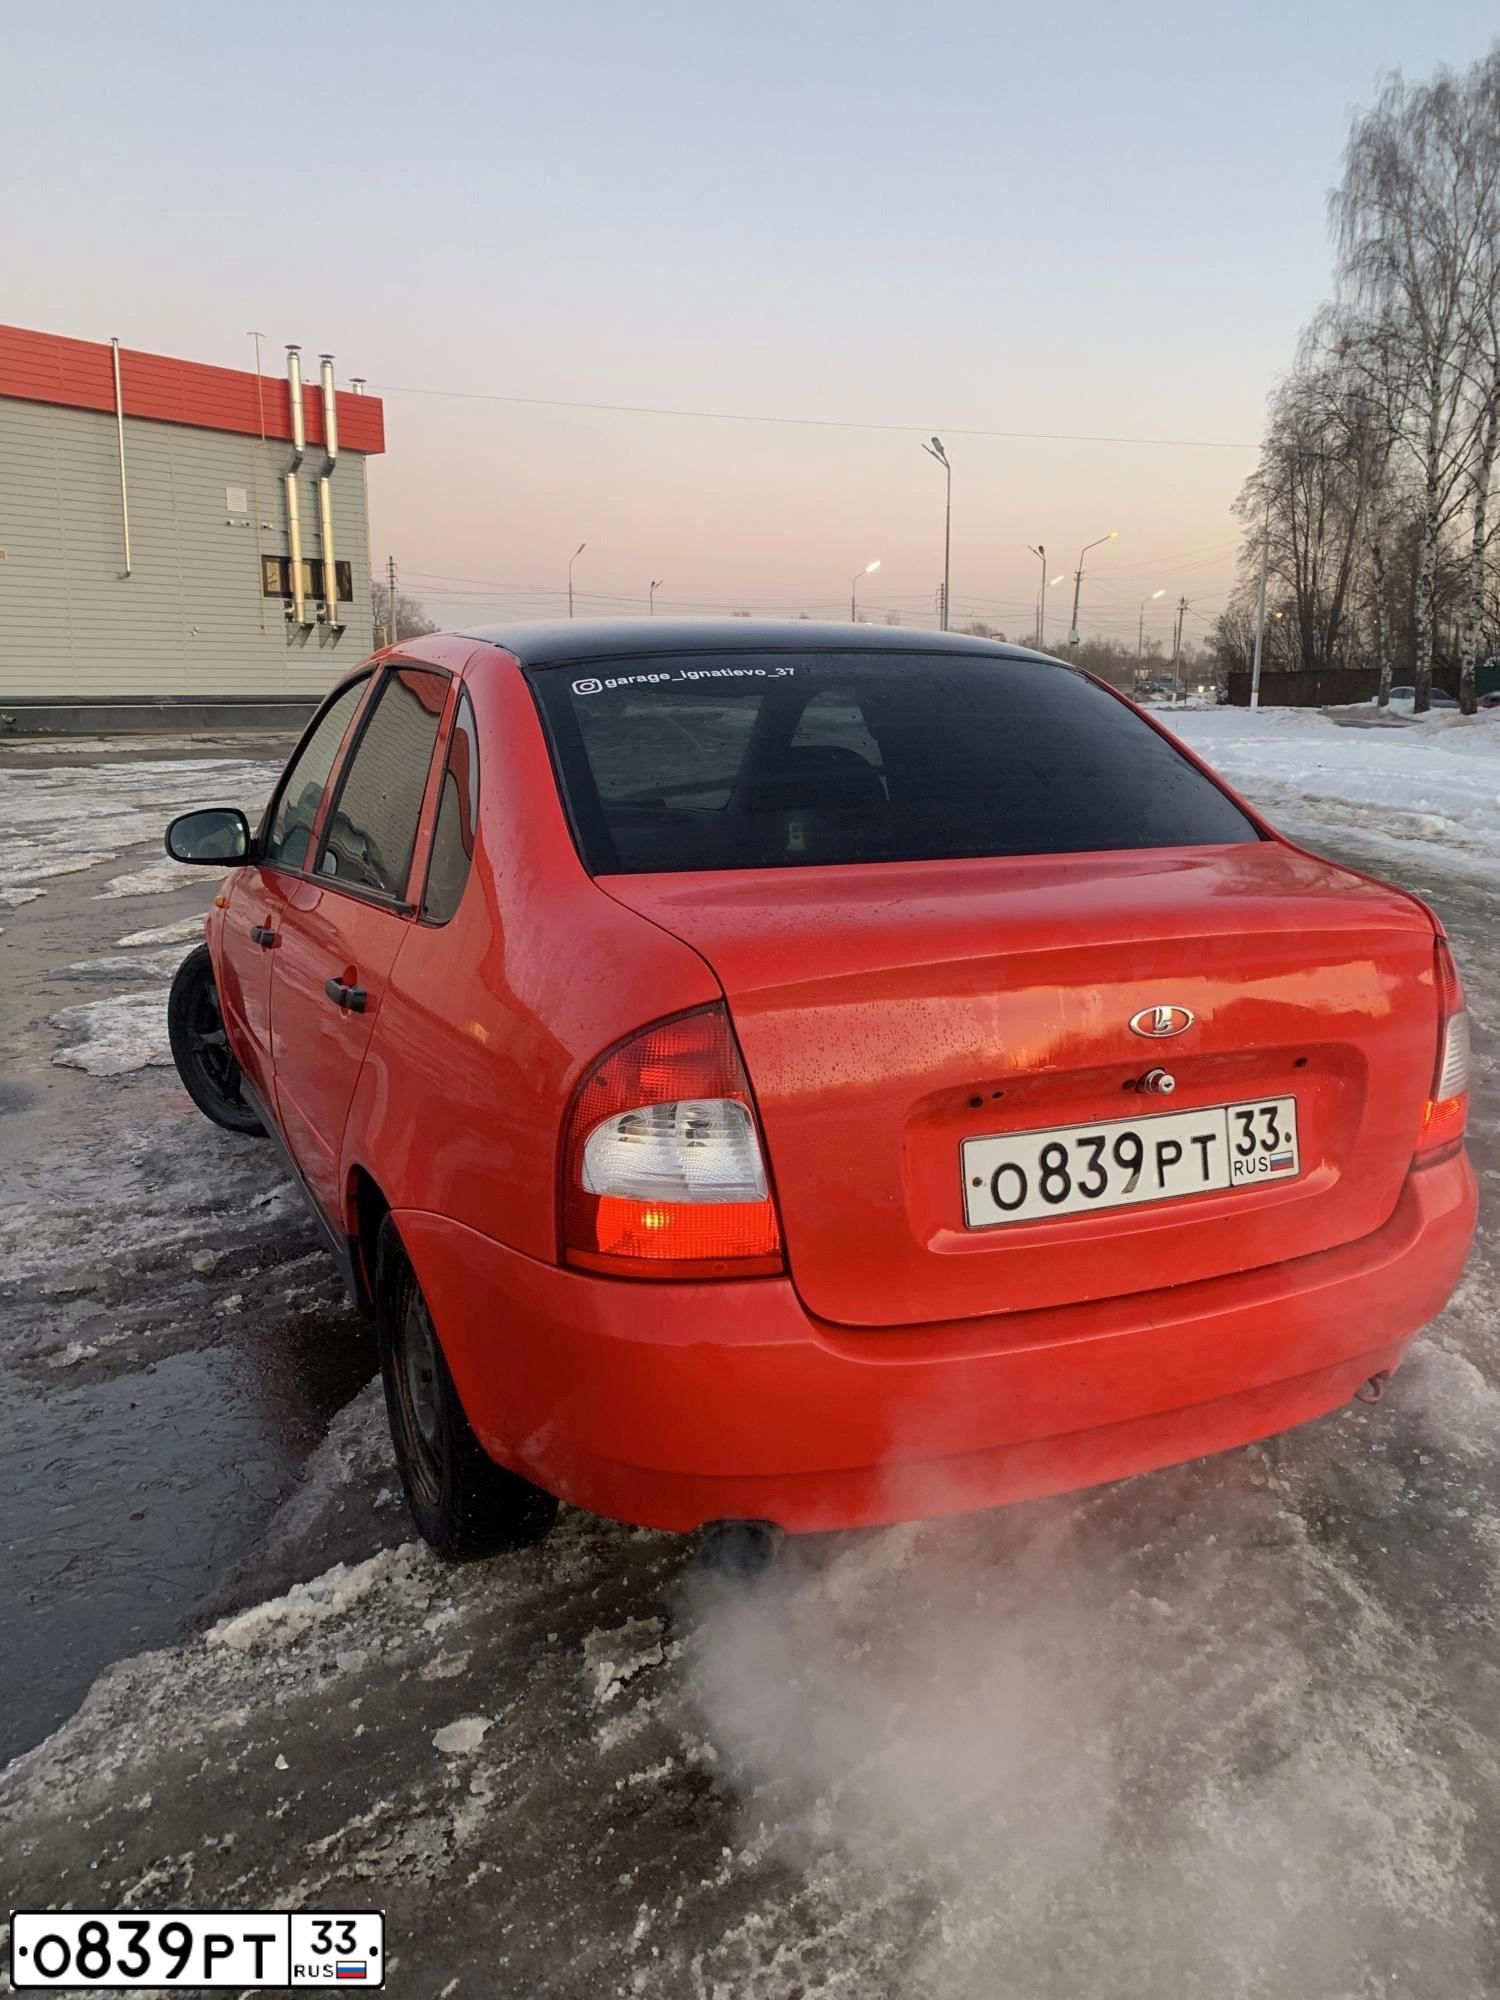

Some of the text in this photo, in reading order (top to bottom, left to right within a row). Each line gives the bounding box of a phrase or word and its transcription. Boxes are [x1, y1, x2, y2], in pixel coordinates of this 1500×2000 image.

[604, 667, 795, 688] garage_ignatievo_37
[1235, 1106, 1280, 1156] 33
[1234, 1156, 1268, 1177] RUS
